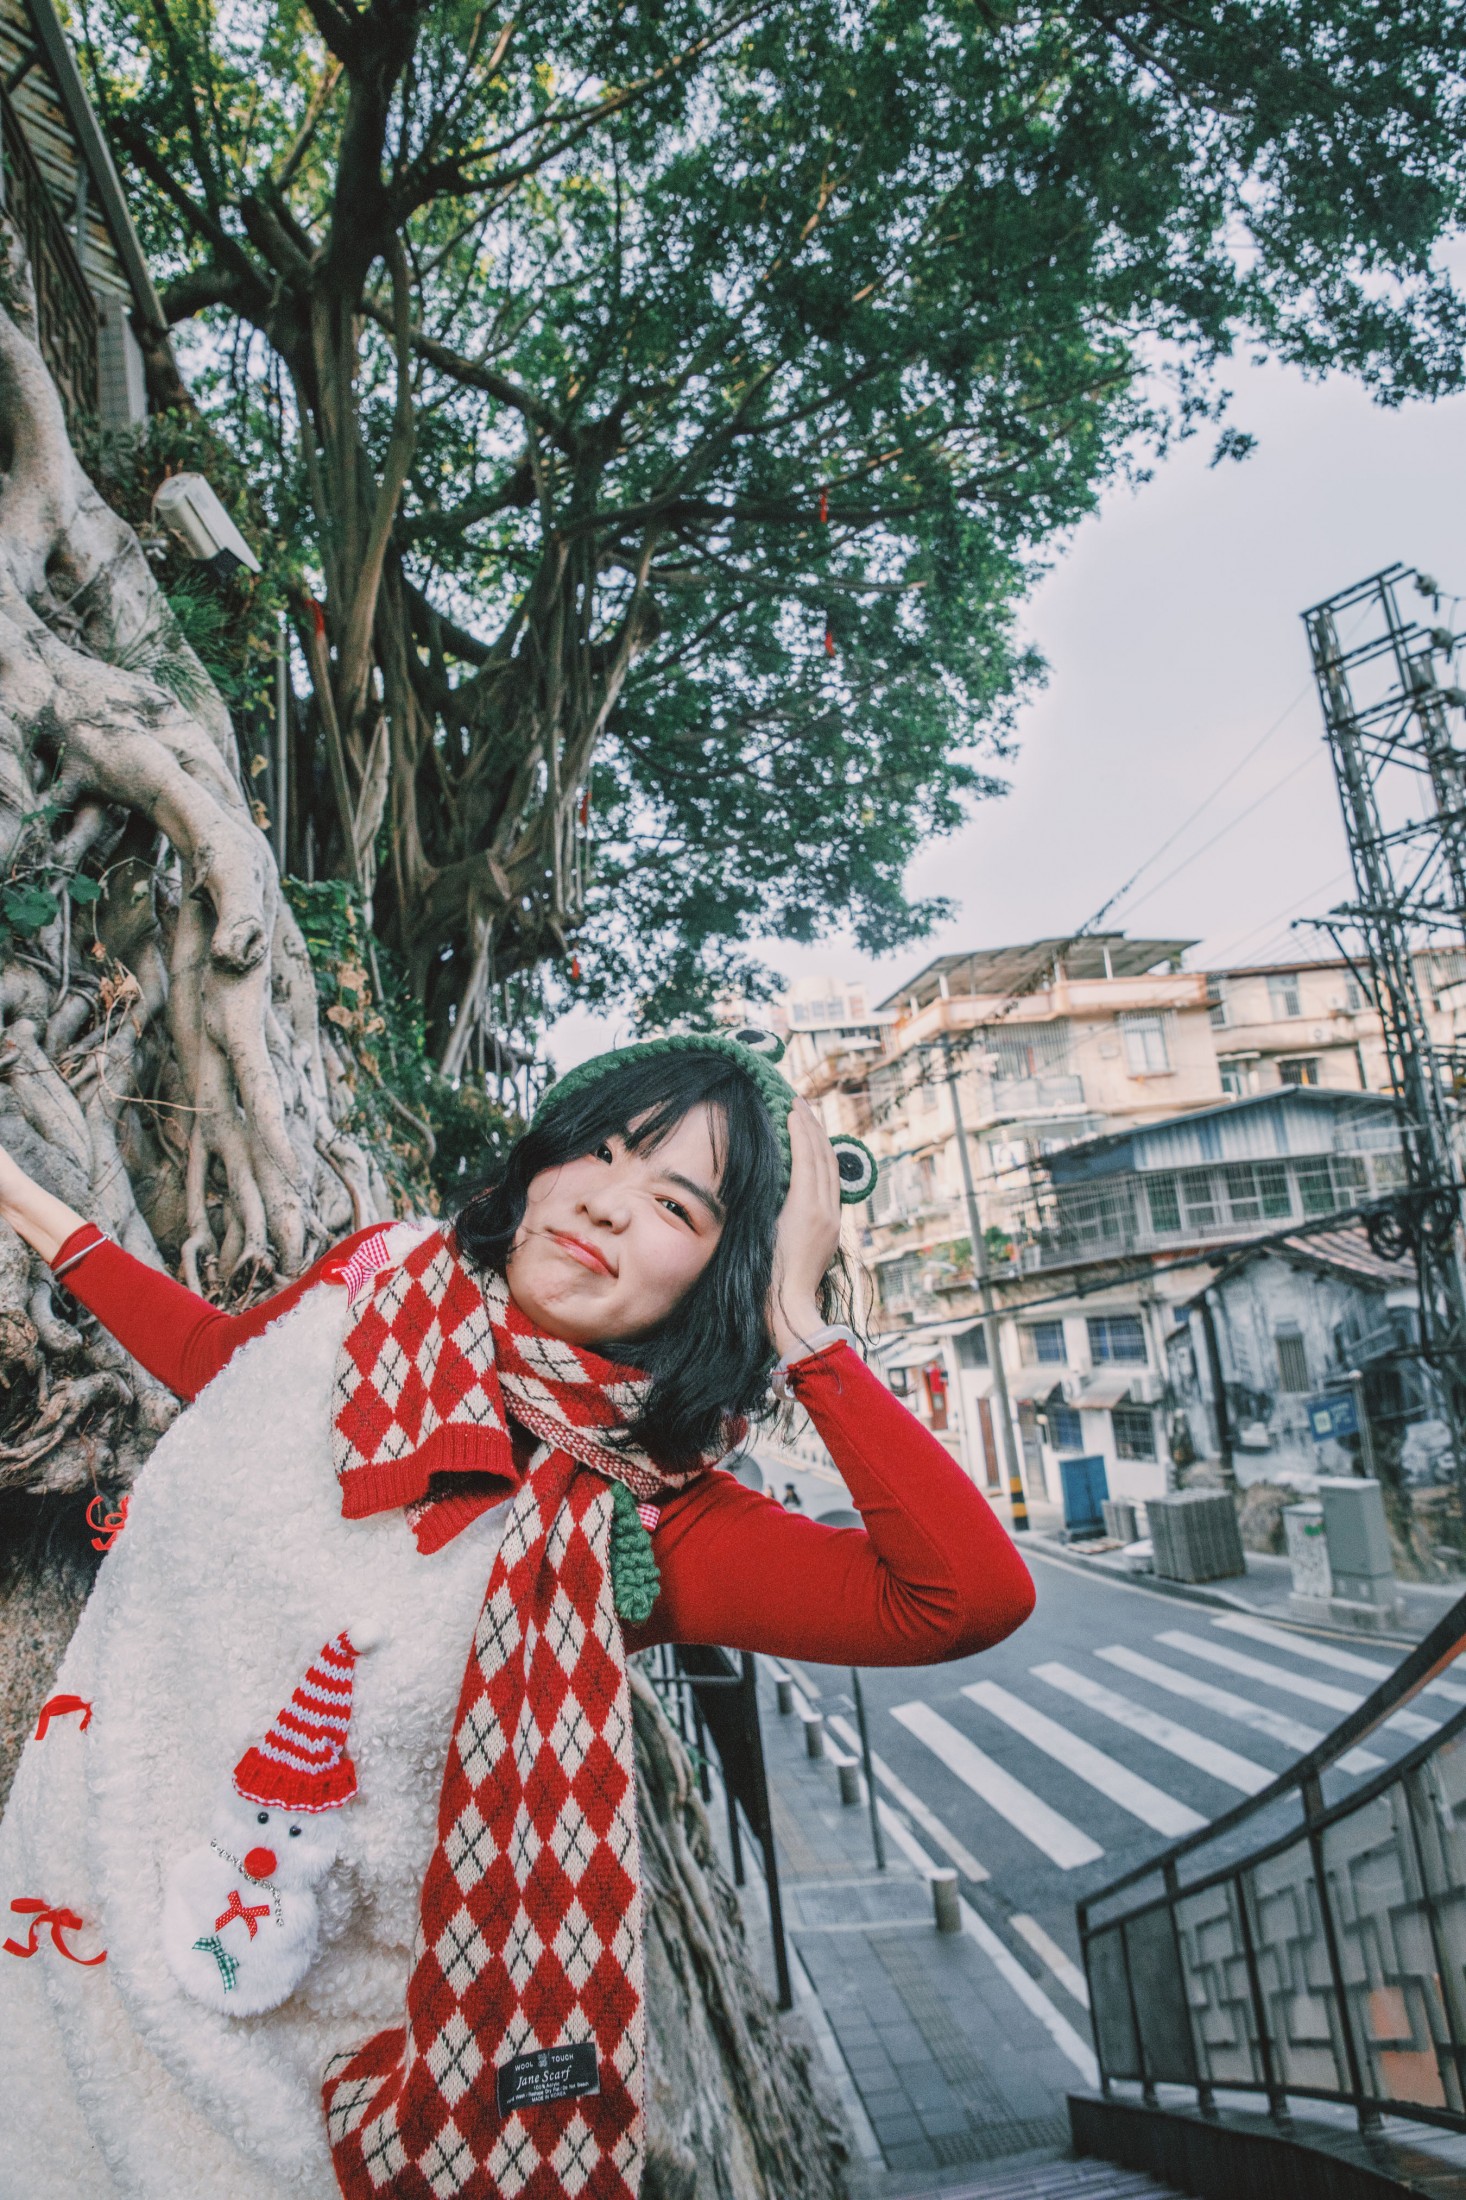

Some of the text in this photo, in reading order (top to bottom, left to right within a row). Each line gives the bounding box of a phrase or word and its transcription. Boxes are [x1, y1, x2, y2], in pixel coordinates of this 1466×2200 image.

[515, 2053, 574, 2072] WOOL TOUCH
[516, 2065, 572, 2091] Jane Scarf
